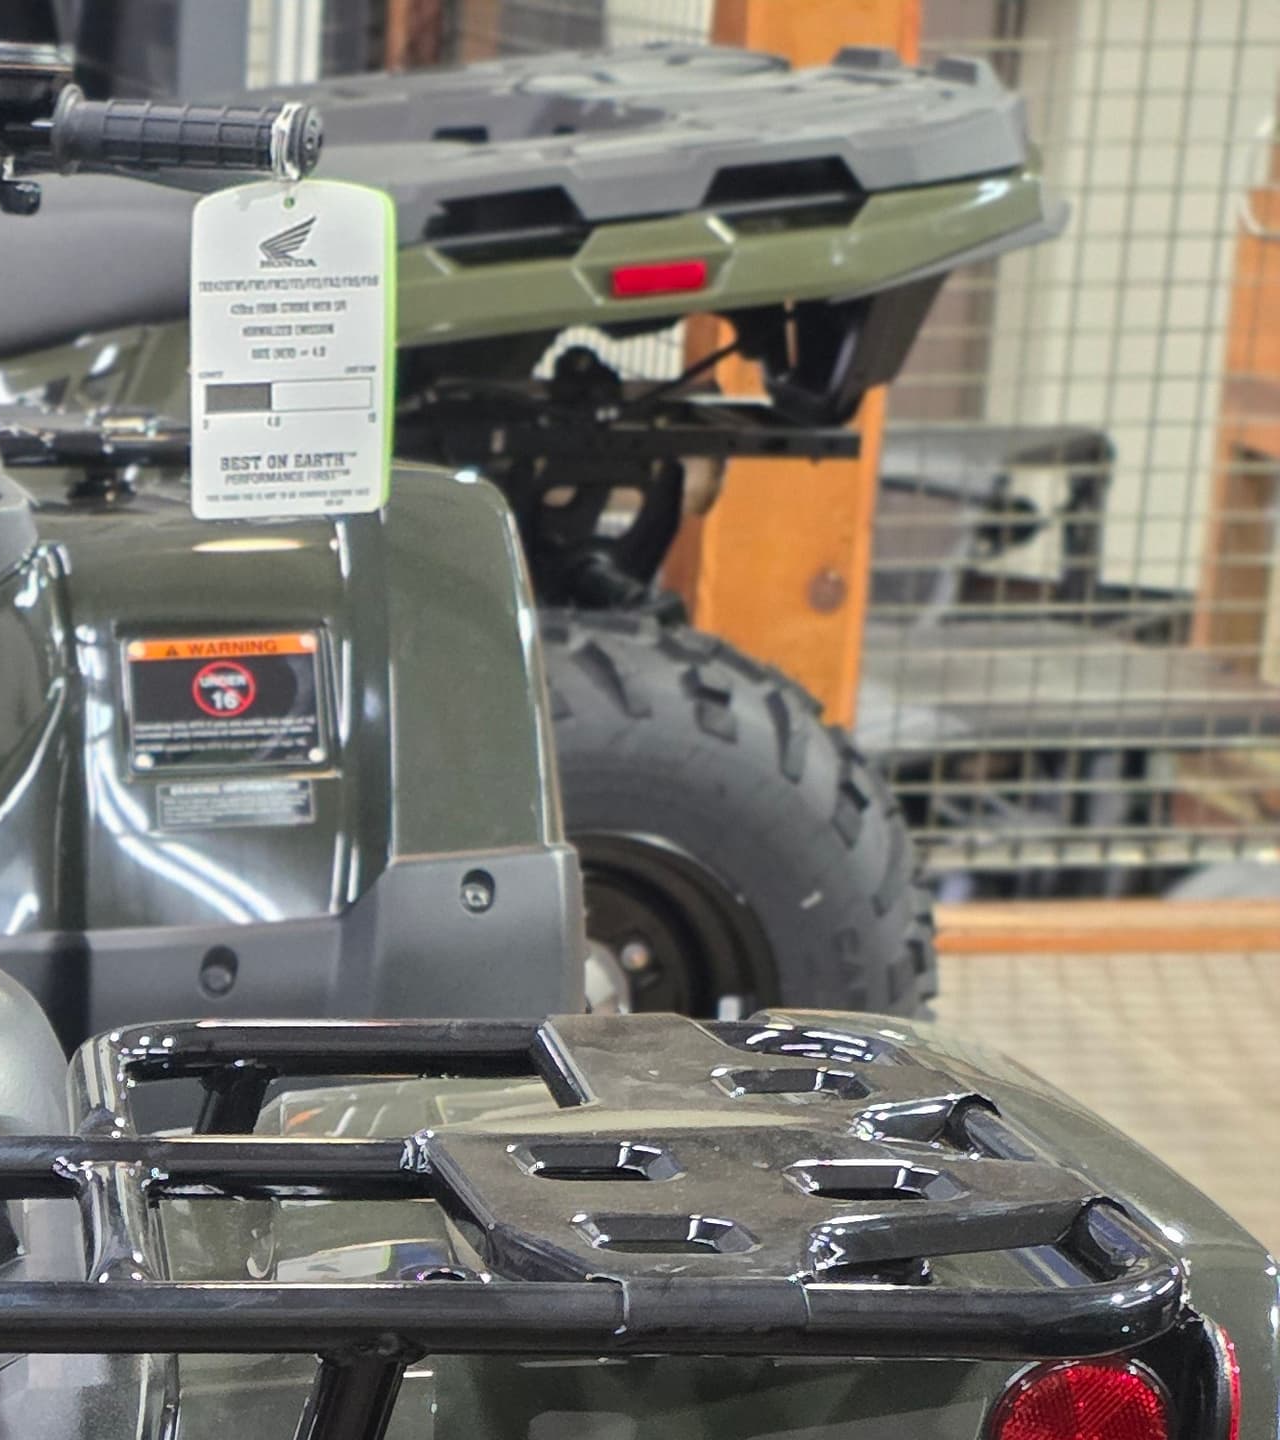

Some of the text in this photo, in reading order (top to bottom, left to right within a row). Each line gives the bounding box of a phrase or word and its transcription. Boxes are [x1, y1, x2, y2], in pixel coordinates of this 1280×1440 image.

[260, 258, 318, 269] HONDA
[220, 456, 262, 471] BEST
[267, 454, 289, 469] ON
[225, 471, 304, 485] PERFORMANCE
[188, 639, 277, 655] WARNING
[212, 690, 239, 710] 16
